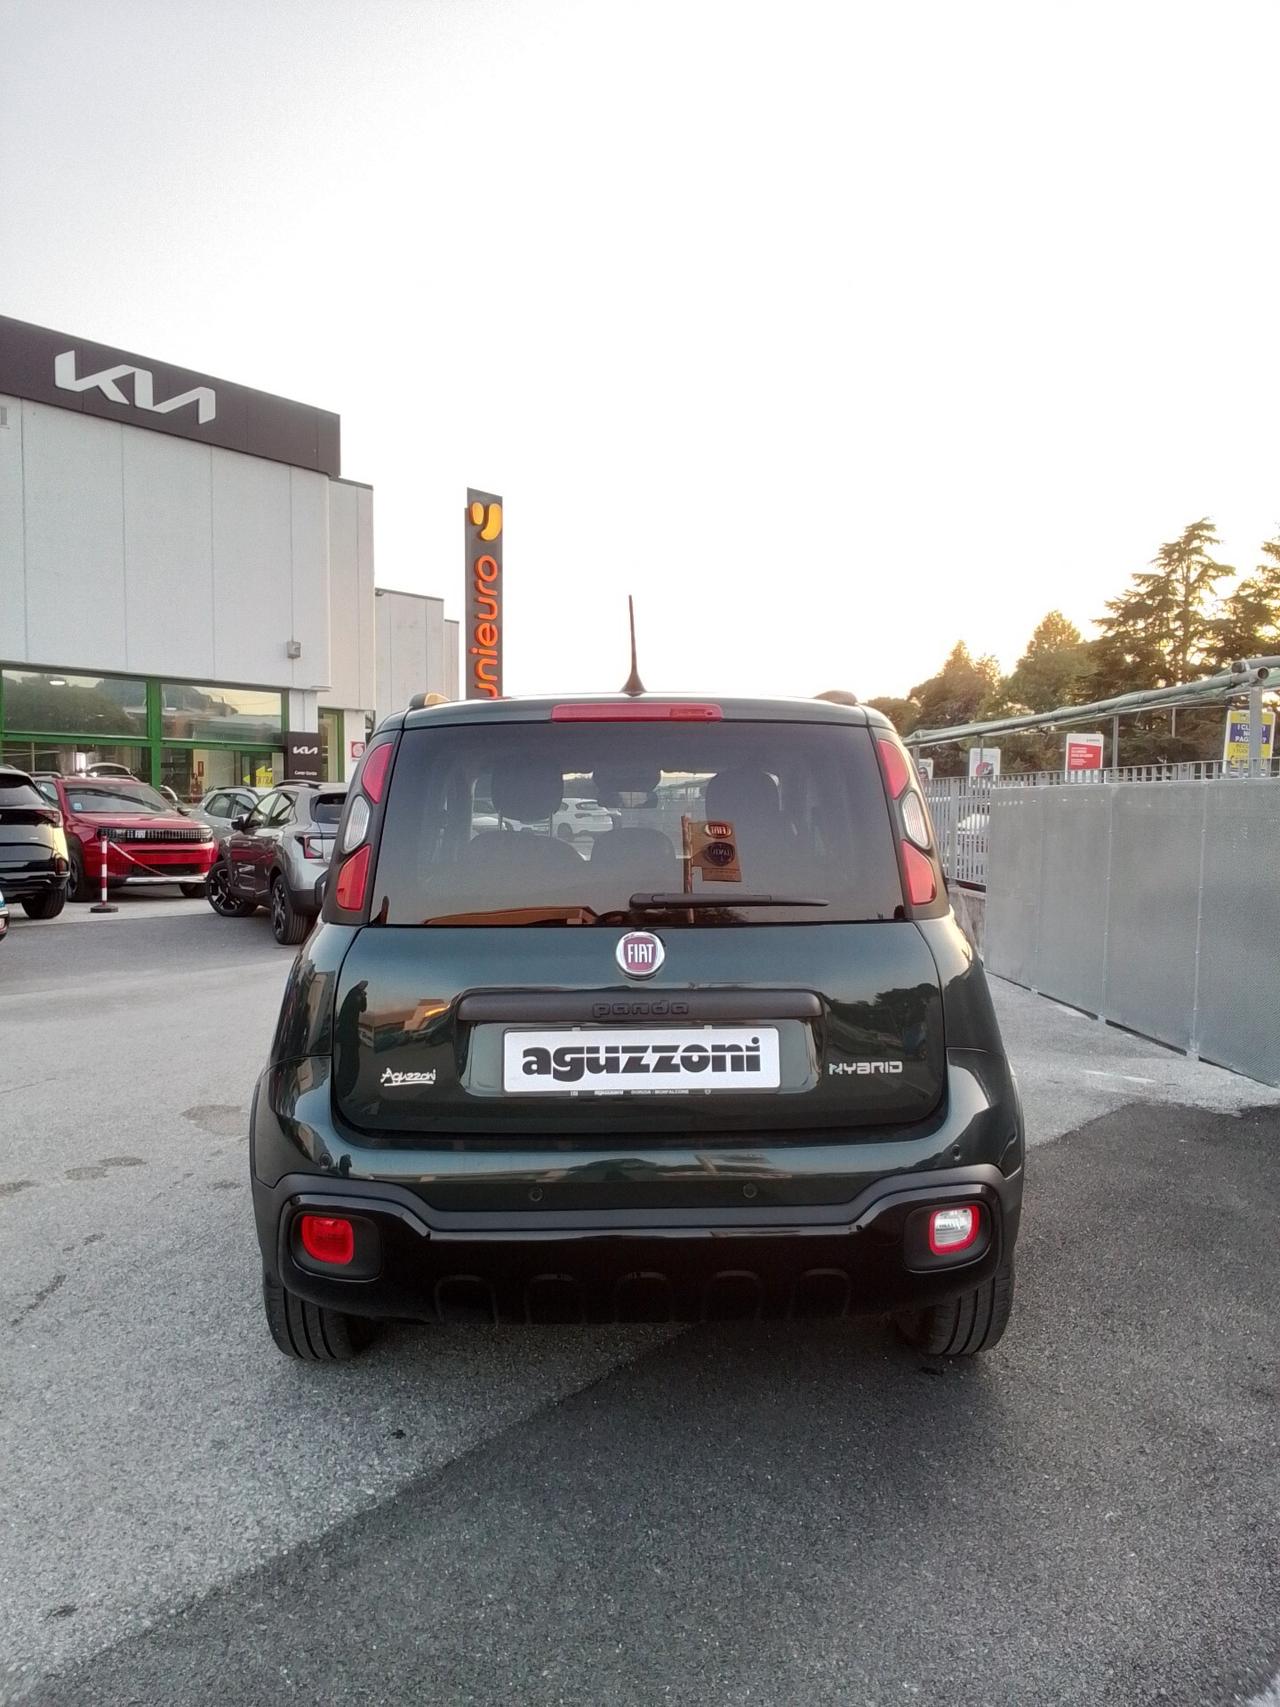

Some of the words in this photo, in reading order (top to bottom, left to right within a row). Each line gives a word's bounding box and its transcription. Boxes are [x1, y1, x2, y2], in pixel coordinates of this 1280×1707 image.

[54, 350, 217, 425] KIA
[627, 943, 654, 964] FIAT
[592, 1000, 689, 1019] panda
[522, 1036, 761, 1083] aguzzoni
[828, 1061, 903, 1075] HYBRID
